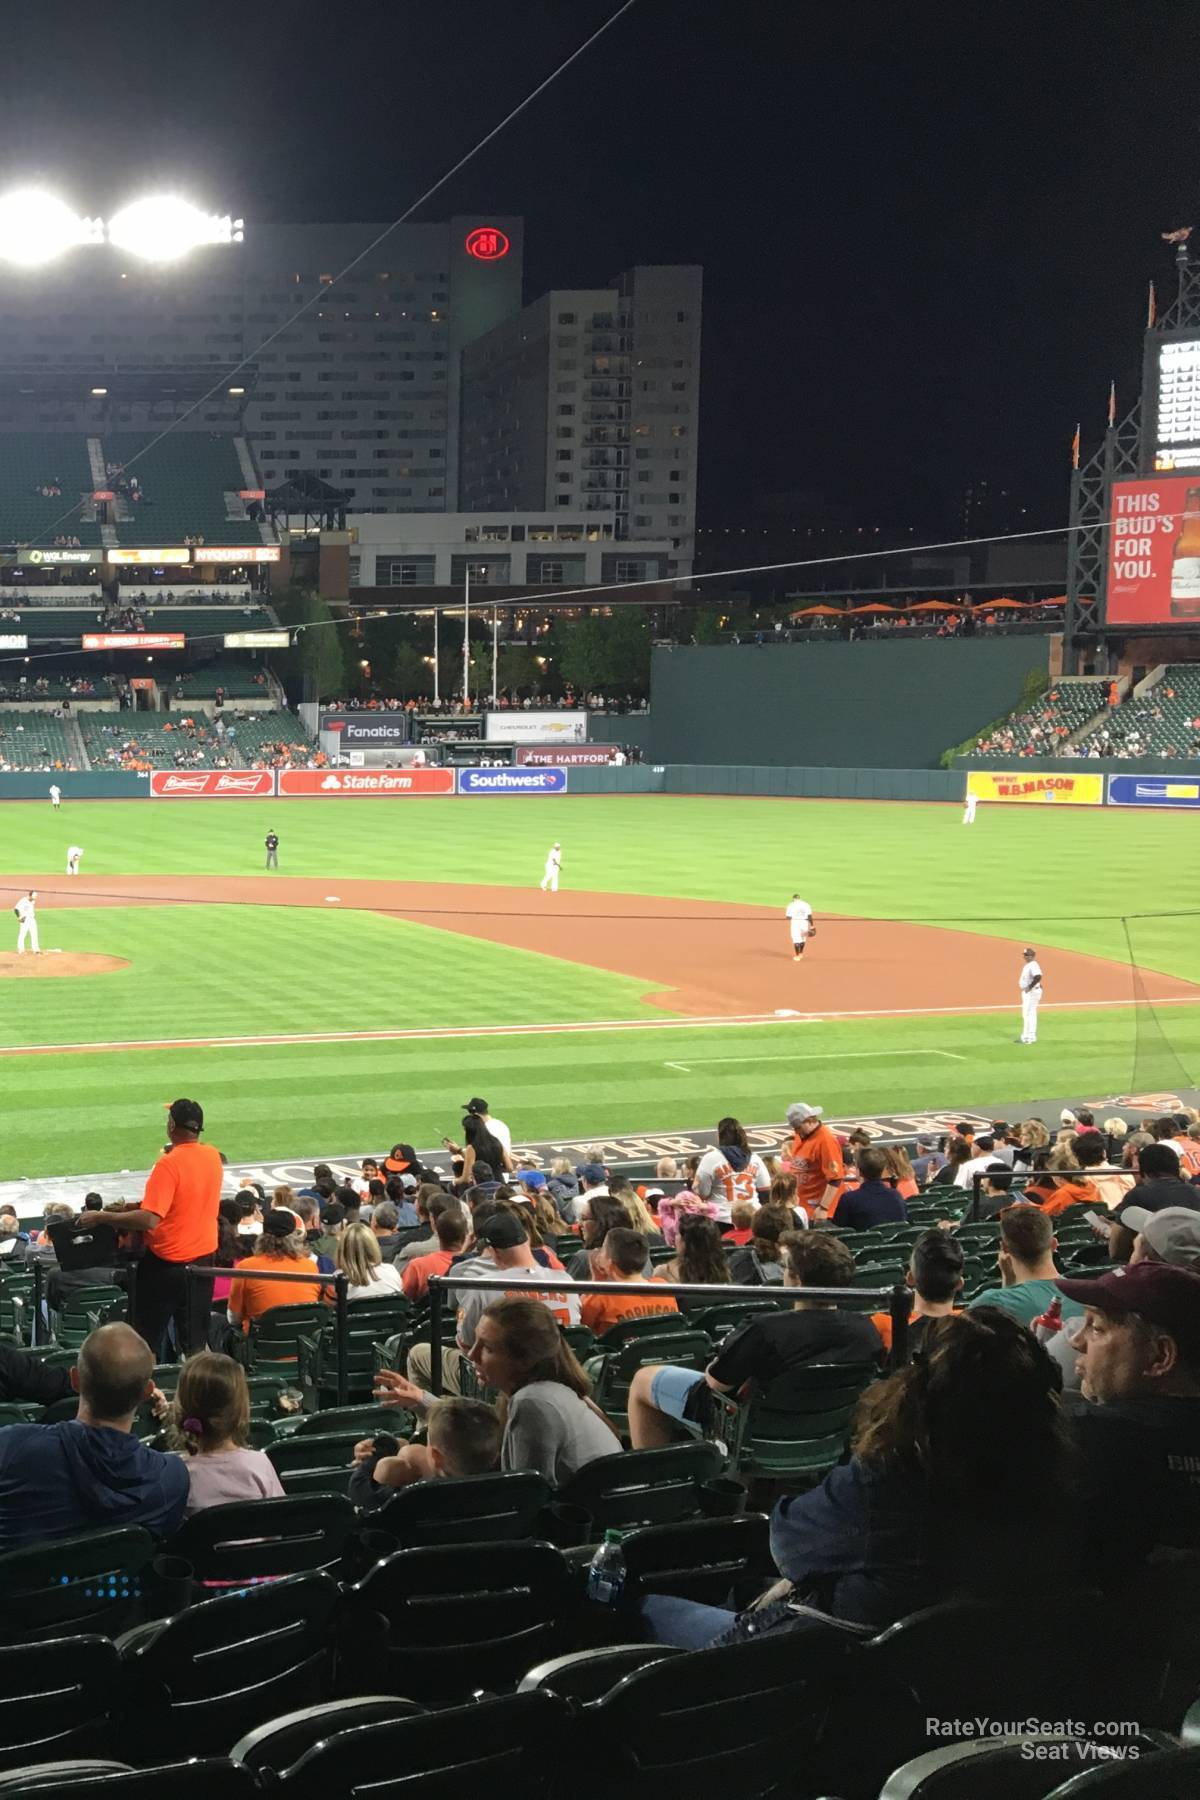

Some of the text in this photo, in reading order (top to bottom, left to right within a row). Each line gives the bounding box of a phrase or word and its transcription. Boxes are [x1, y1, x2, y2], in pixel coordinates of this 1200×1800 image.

[1116, 493, 1160, 513] THIS
[1115, 515, 1174, 536] BUD'S
[63, 551, 91, 563] Energy
[1114, 538, 1152, 558] FOR
[1113, 560, 1157, 580] YOU.
[347, 725, 401, 738] Fanatics
[533, 754, 553, 764] THE
[469, 773, 546, 788] Southwest
[722, 1173, 754, 1201] 13
